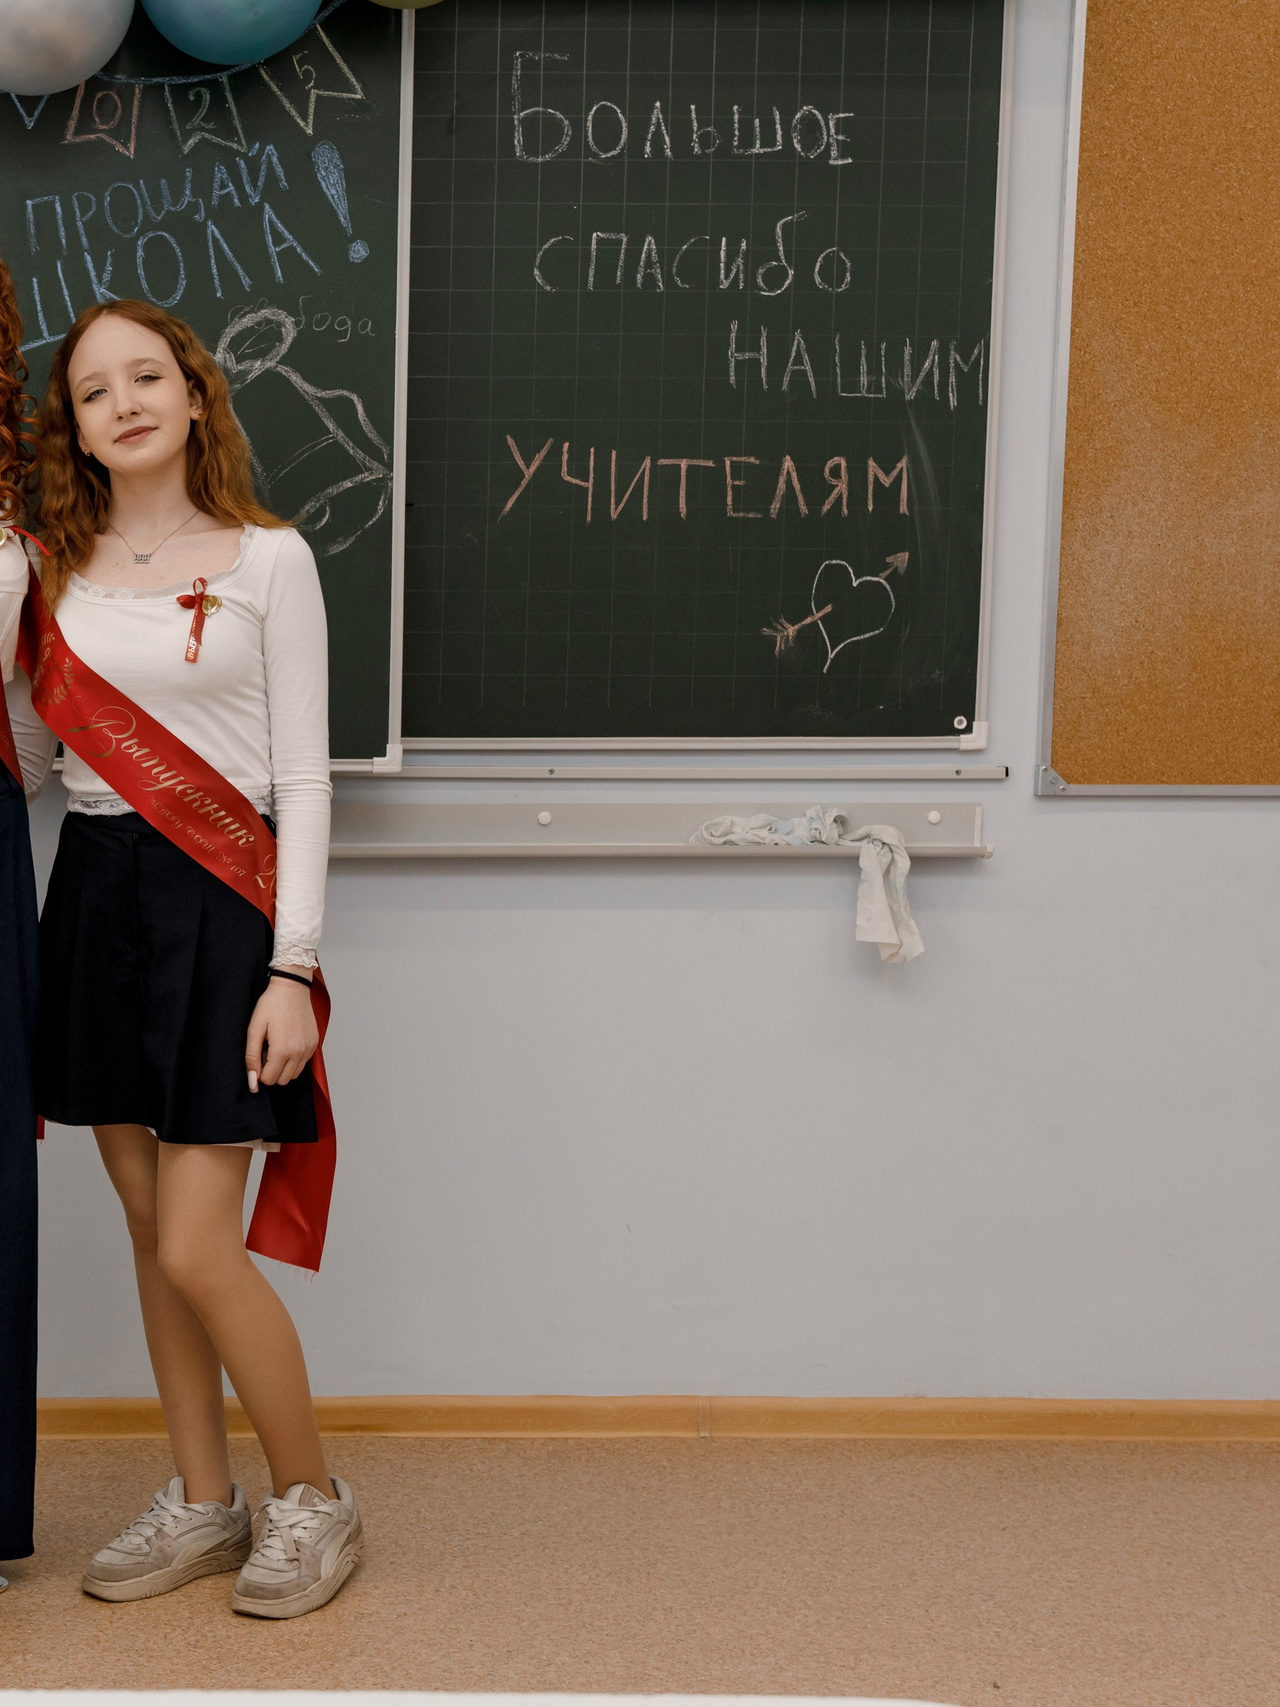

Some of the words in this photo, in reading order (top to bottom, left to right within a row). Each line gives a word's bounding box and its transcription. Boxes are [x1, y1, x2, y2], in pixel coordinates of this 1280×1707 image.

[25, 141, 290, 255] ПРОЩАЙ
[728, 319, 987, 411] НАШИМ
[497, 434, 910, 524] УЧИТЕЛЯМ
[230, 865, 247, 877] 107
